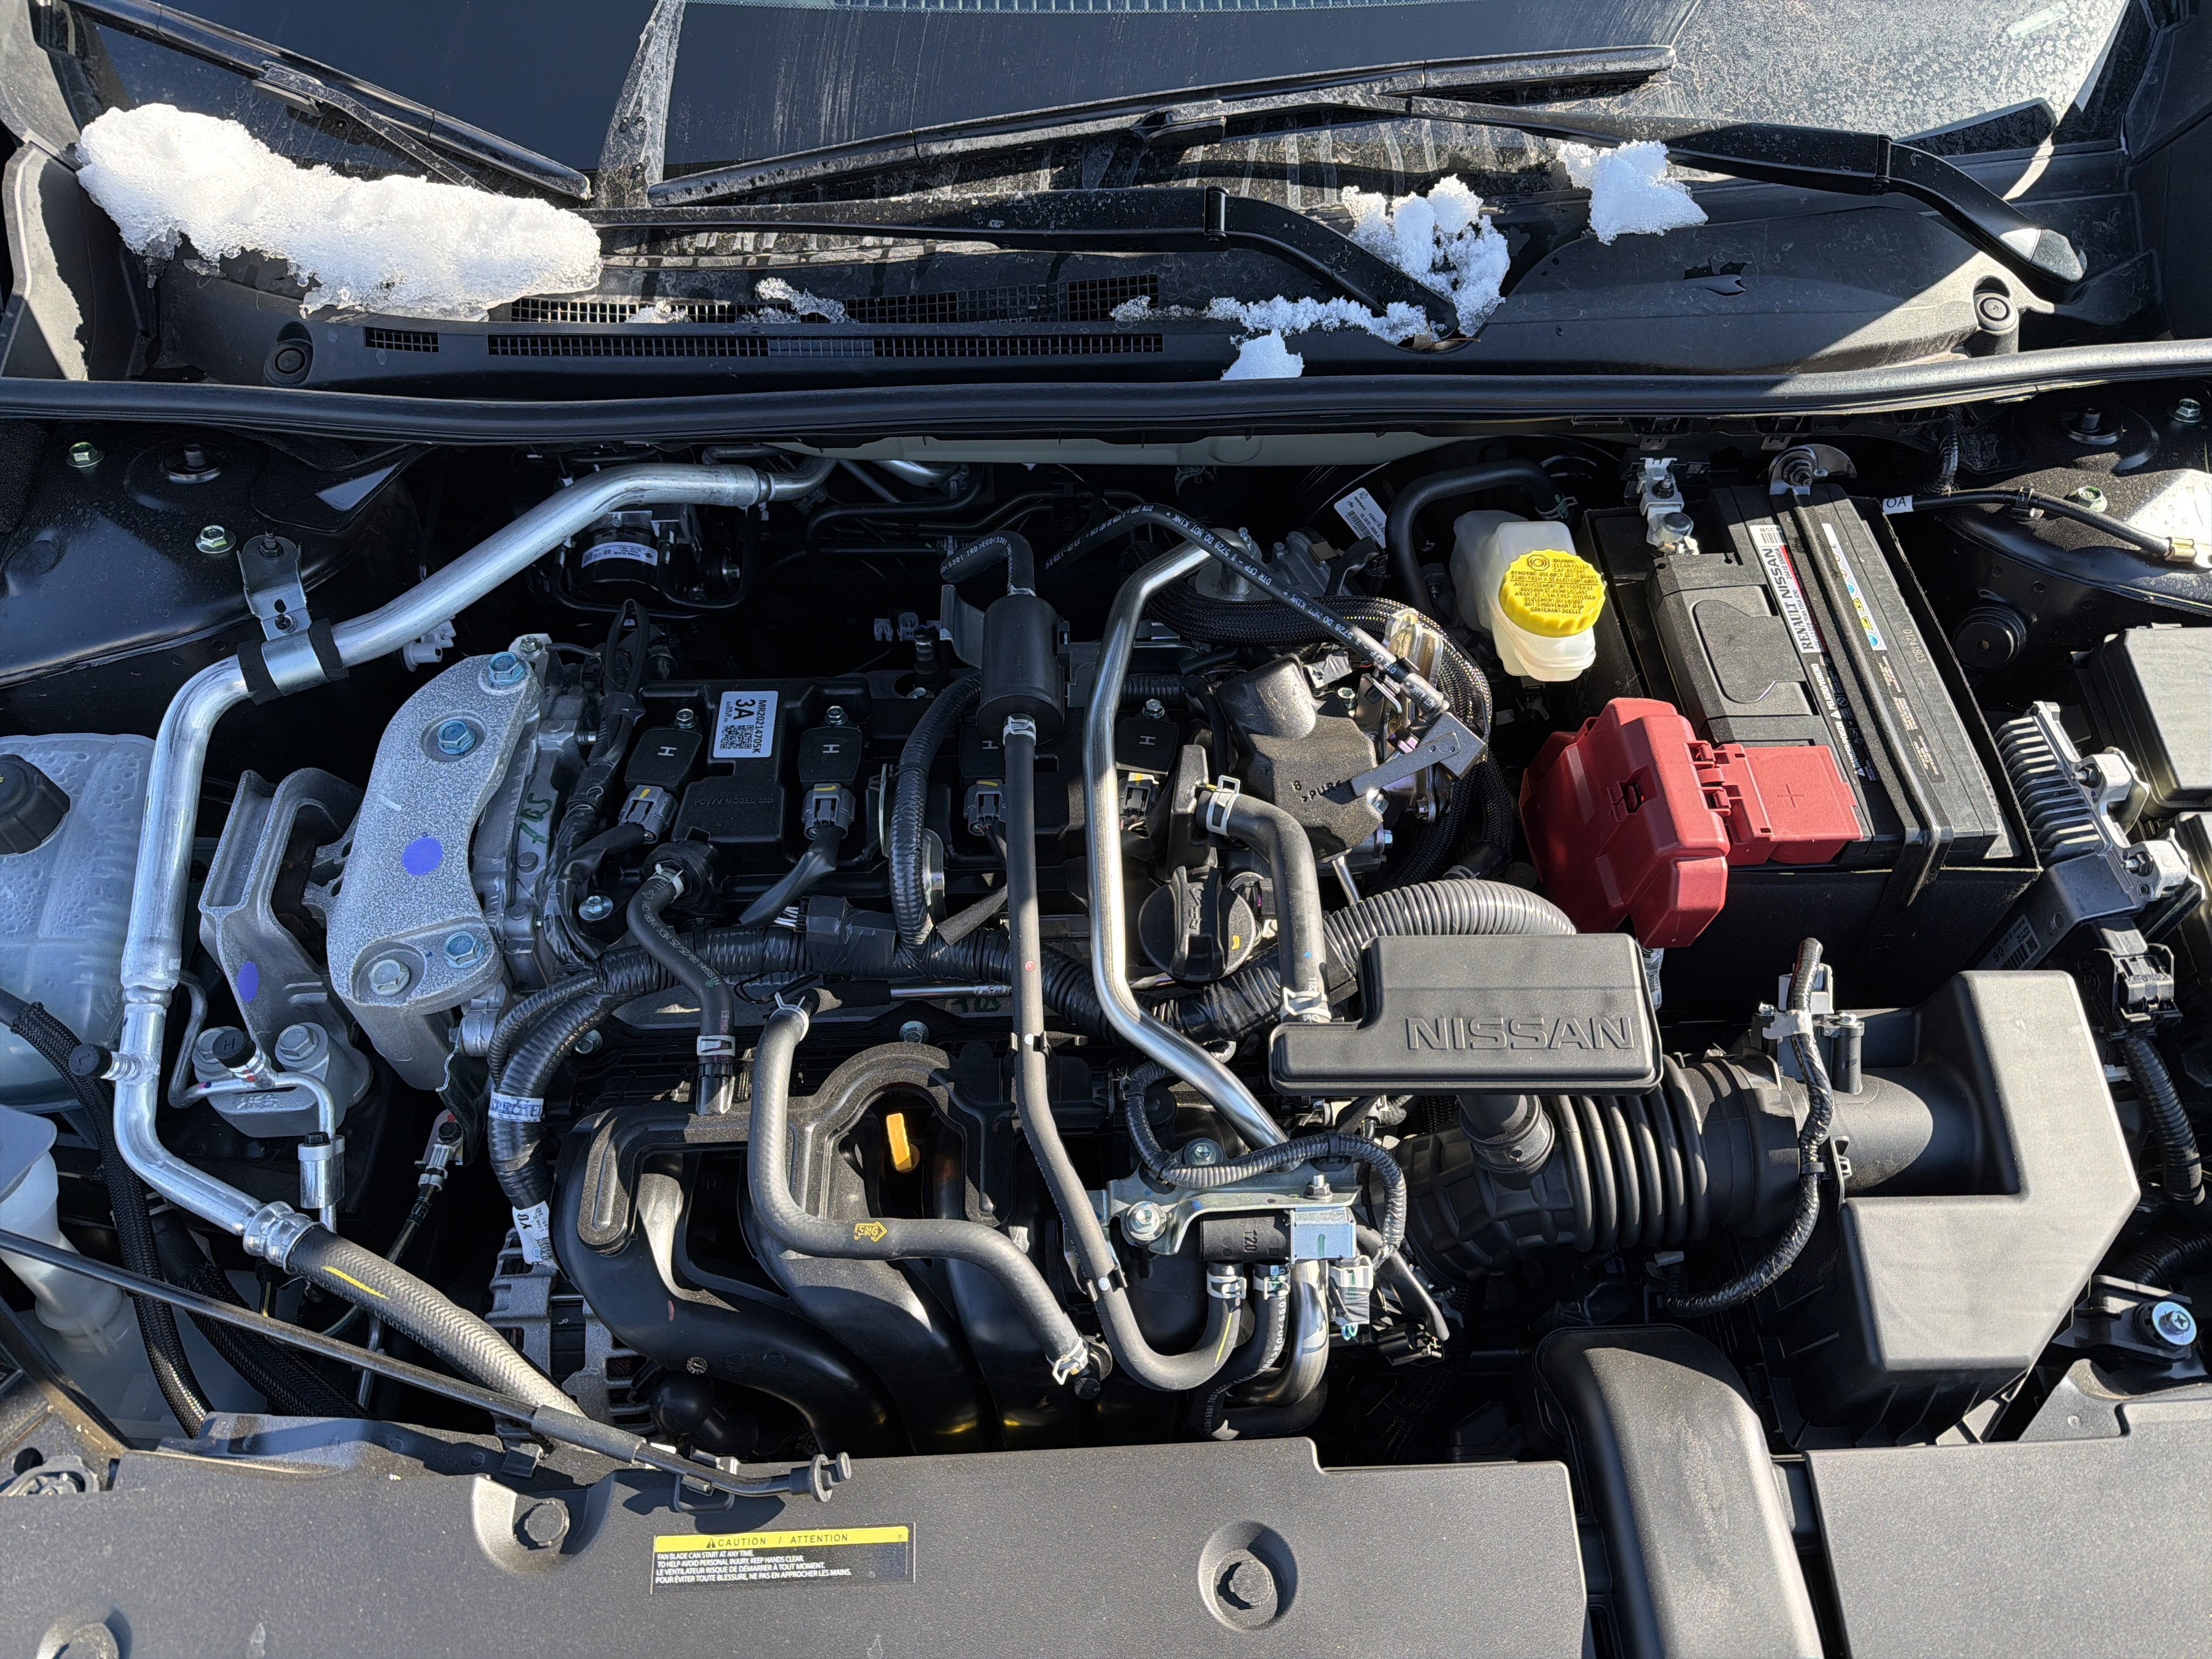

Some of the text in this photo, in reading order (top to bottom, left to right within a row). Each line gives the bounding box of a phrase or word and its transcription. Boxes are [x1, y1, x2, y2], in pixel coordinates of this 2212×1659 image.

[1245, 565, 1258, 575] CFP
[1259, 572, 1272, 585] DTR
[1762, 548, 1792, 599] NISSAN
[1784, 602, 1814, 650] RENAULT
[1902, 628, 1927, 664] 01241803
[734, 698, 756, 720] 3A
[752, 699, 768, 754] MR20214705K
[1405, 1017, 1634, 1050] NISSAN
[718, 1537, 766, 1547] CAUTION
[790, 1534, 848, 1543] ATTENTION
[675, 1575, 695, 1583] ÉVITER
[739, 1564, 772, 1572] DÉMARRER
